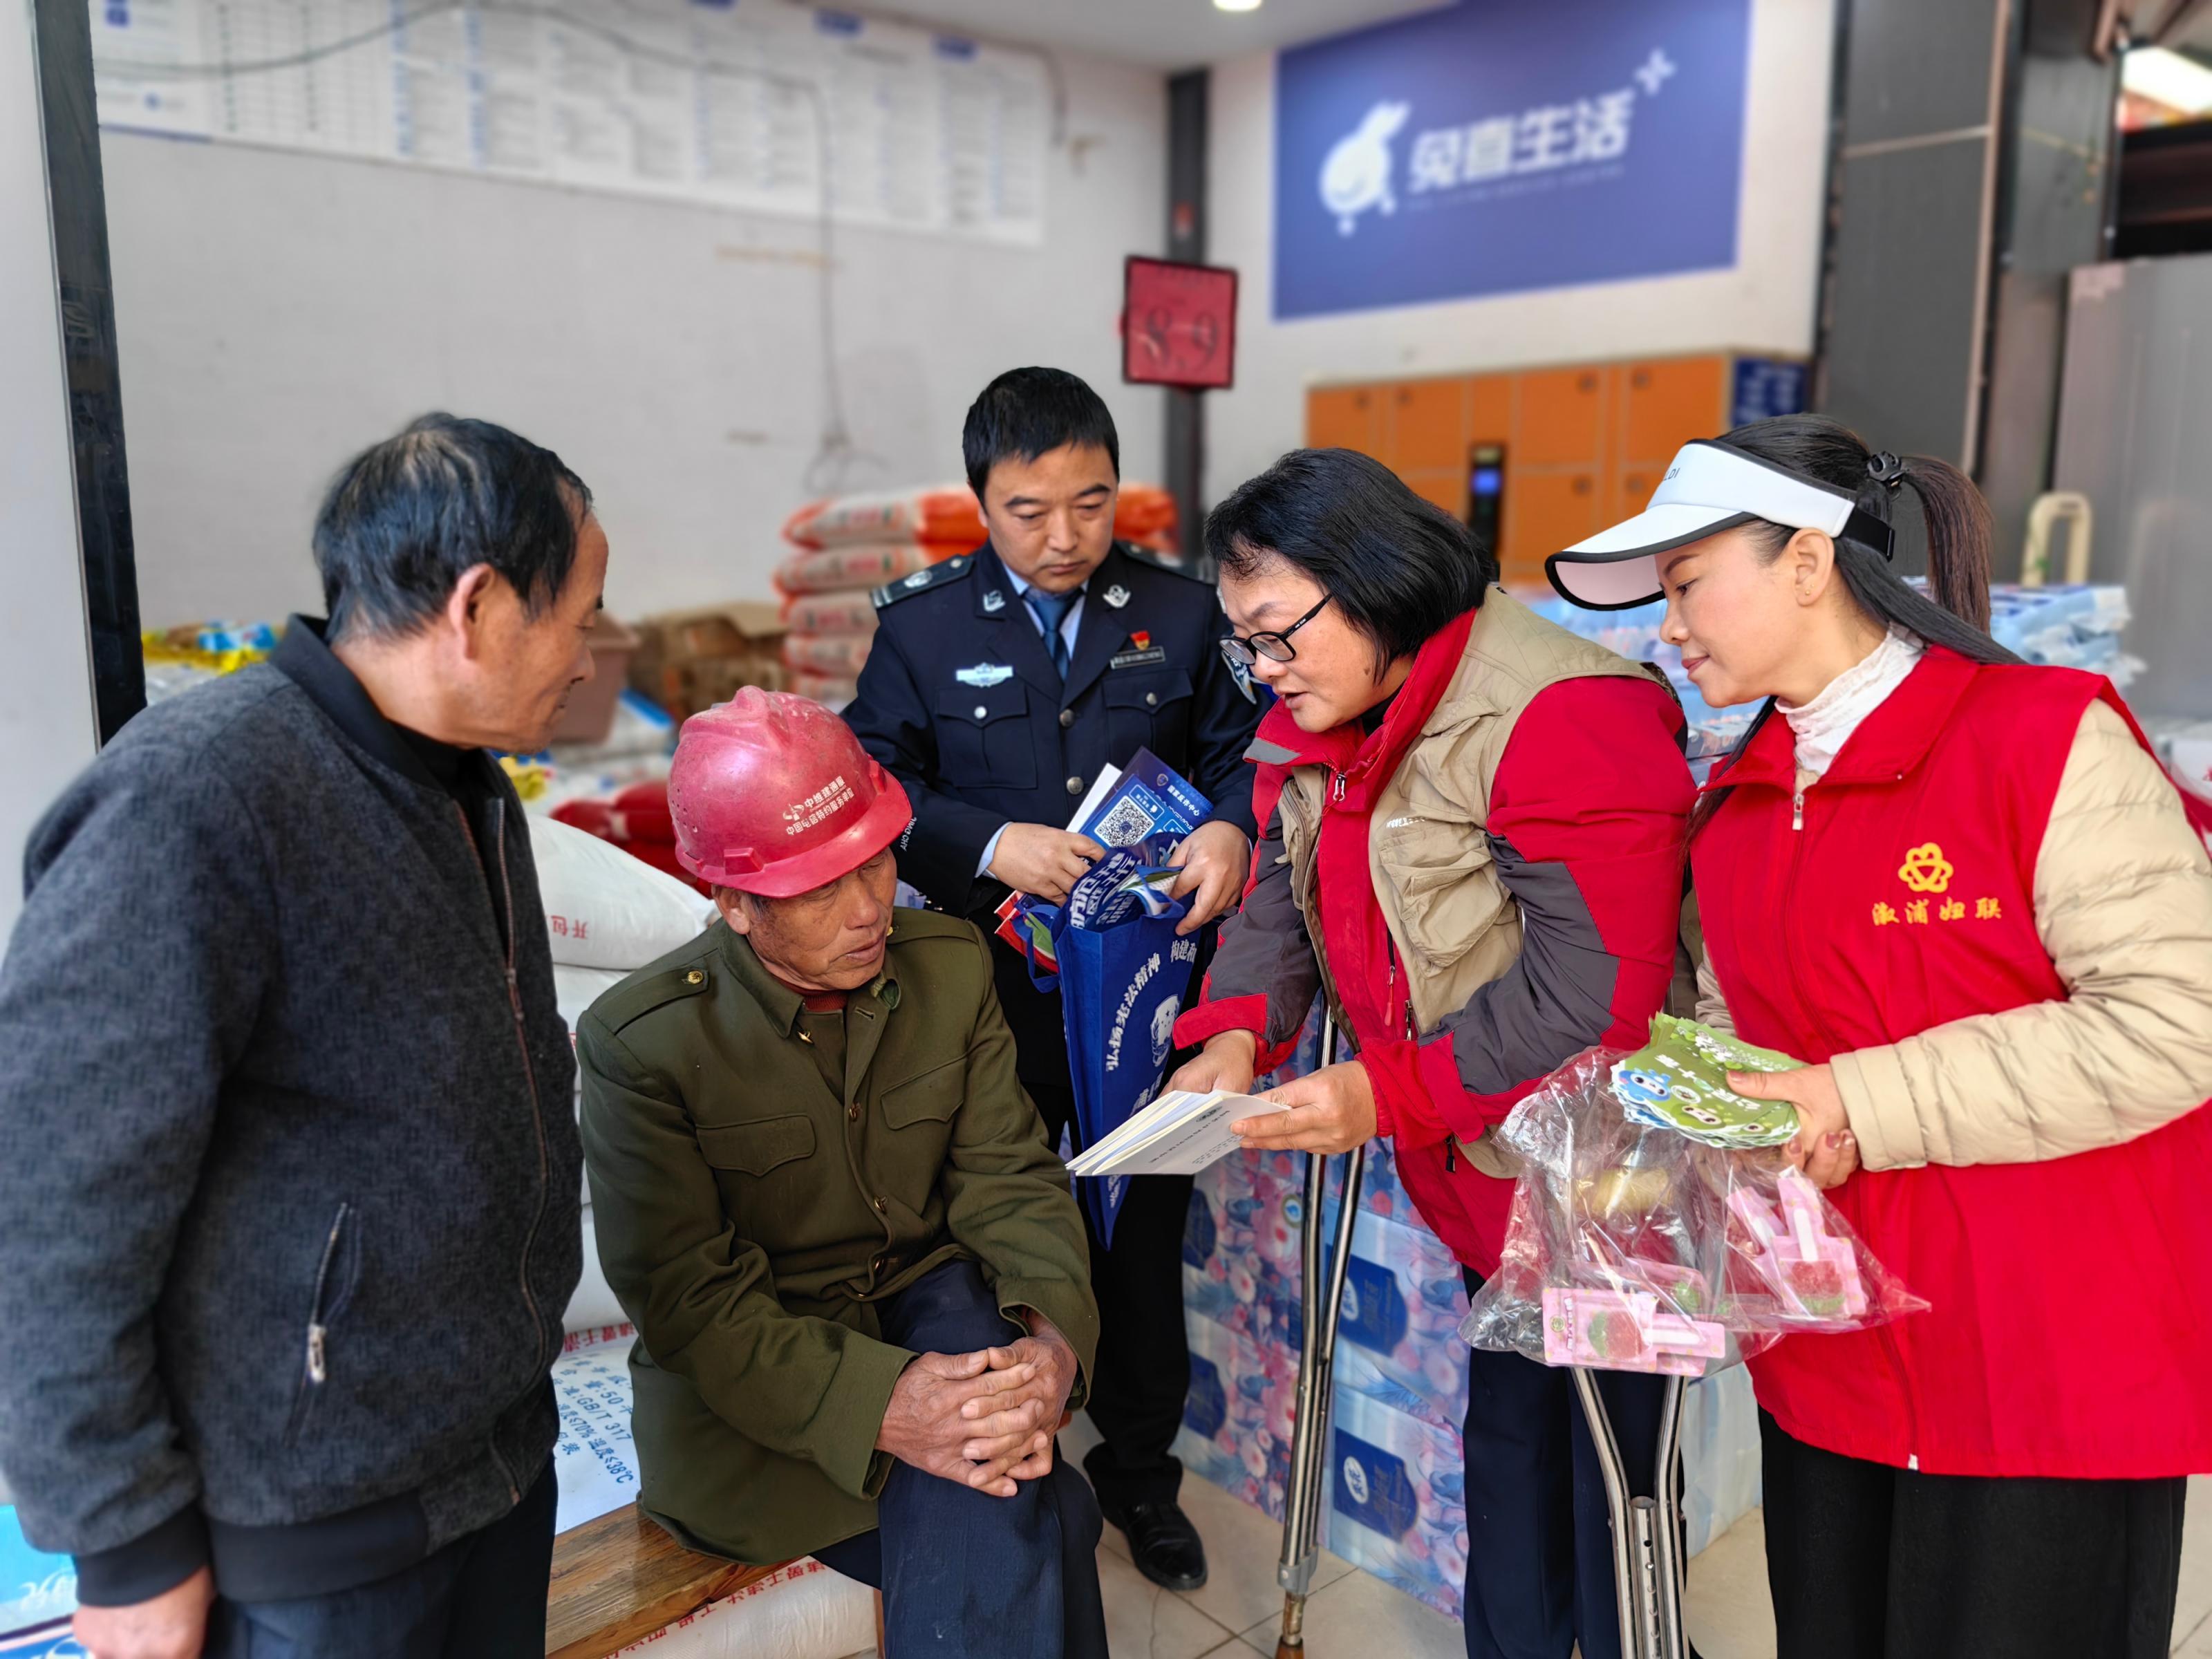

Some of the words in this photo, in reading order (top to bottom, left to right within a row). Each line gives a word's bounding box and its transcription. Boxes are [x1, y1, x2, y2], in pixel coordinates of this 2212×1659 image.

[785, 787, 854, 836] 中国电信特约服务单位
[1167, 785, 1200, 817] 国家反诈中心
[1106, 952, 1161, 1072] 弘扬宪法精神
